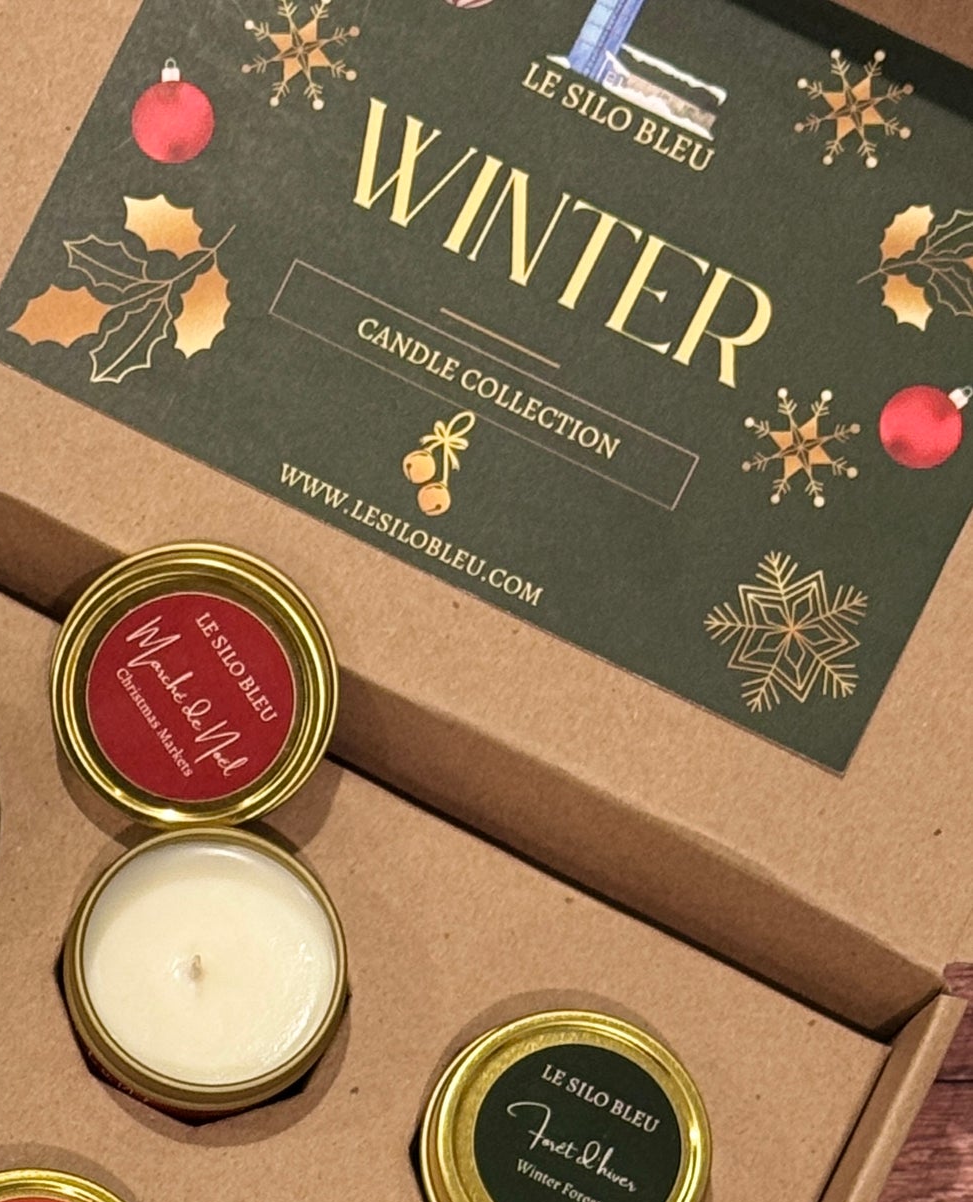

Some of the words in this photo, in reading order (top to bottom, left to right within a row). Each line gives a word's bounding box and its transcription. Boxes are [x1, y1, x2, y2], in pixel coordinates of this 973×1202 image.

[521, 61, 562, 98] LE
[561, 82, 632, 131] SILO
[633, 117, 715, 170] BLEU
[352, 96, 772, 388] WINTER
[357, 318, 460, 381] CANDLE
[460, 368, 620, 459] COLLECTION
[280, 462, 543, 606] WWW.LESILOBLEU.COM
[180, 698, 211, 731] de
[195, 611, 219, 637] LE
[210, 634, 245, 676] SILO
[237, 674, 277, 721] BLEU
[115, 667, 161, 729] Christmas
[156, 727, 193, 777] Markets
[541, 1063, 566, 1086] LE
[565, 1076, 609, 1107] SILO
[609, 1098, 660, 1132] BLEU
[516, 1158, 561, 1190] Winter
